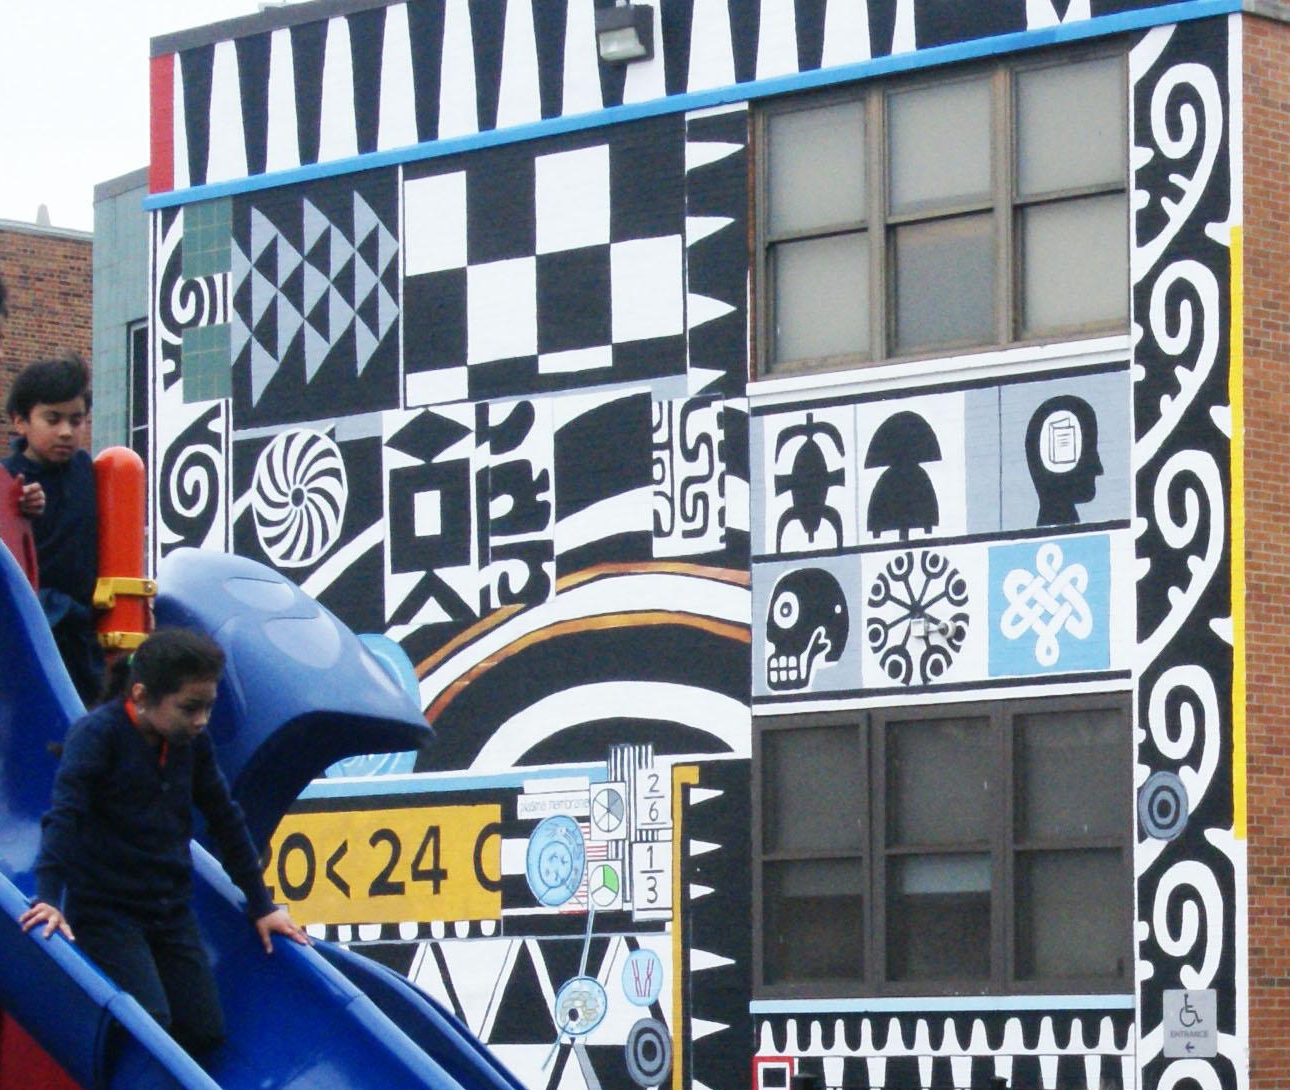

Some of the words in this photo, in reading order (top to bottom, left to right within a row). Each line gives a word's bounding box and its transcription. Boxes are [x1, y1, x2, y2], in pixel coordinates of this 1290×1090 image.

[647, 773, 661, 794] 2
[648, 801, 659, 822] 6
[646, 845, 654, 869] 1
[646, 876, 658, 904] 3
[1170, 1030, 1209, 1039] ENTRANCE
